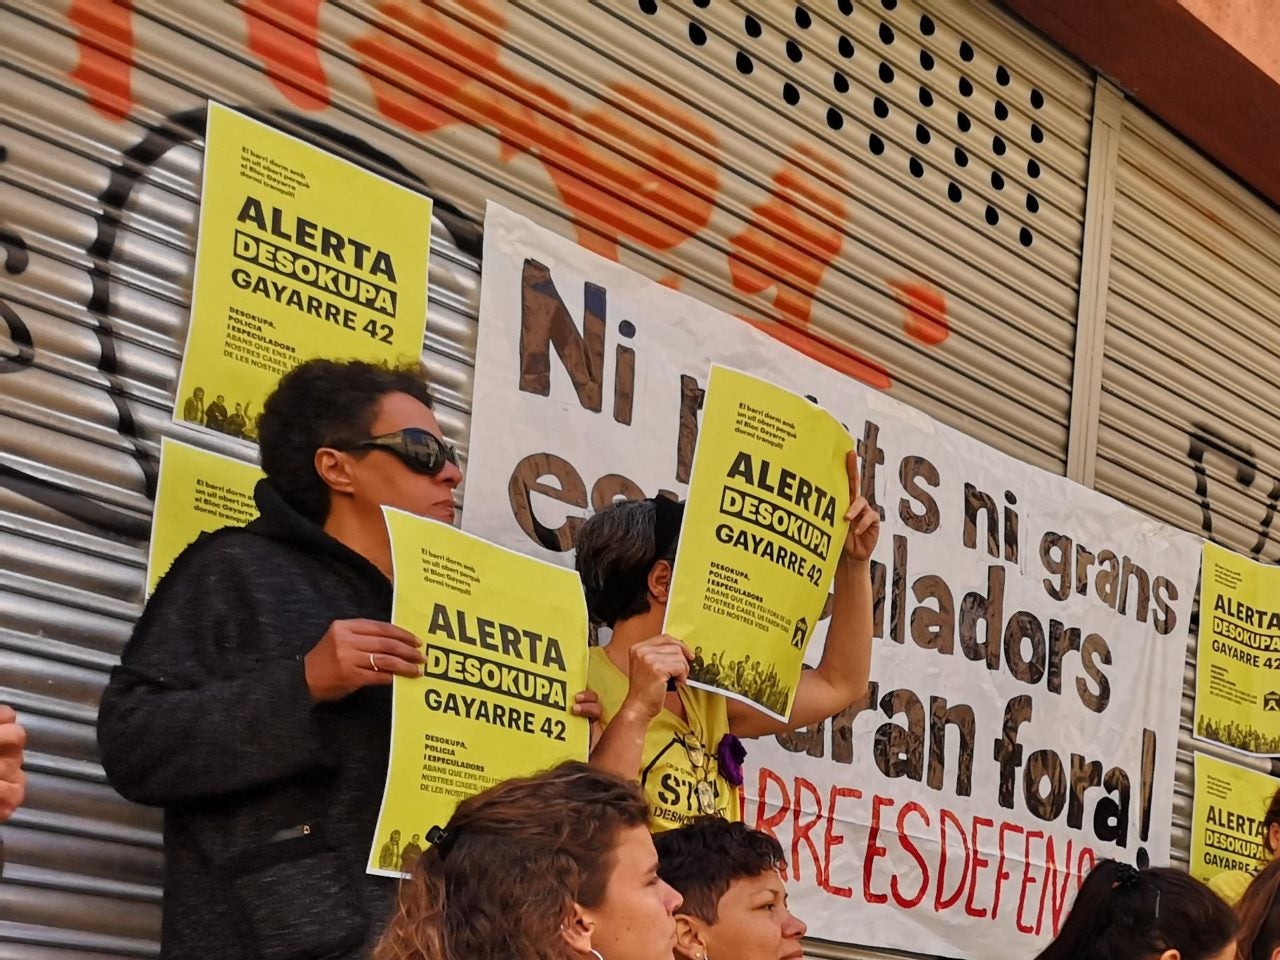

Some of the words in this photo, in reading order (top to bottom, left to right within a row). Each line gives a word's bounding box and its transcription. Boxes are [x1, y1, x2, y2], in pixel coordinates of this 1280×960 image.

[237, 196, 398, 284] ALERTA
[232, 268, 356, 331] GAYARRE
[362, 318, 394, 345] 42
[236, 236, 394, 316] DESOKUPA
[520, 258, 637, 427] Ni
[963, 482, 1018, 565] ni
[1039, 531, 1179, 635] grans
[727, 452, 836, 528] ALERTA
[721, 487, 829, 560] DESOKUPA
[716, 523, 806, 578] GAYARRE
[807, 562, 823, 588] 42
[428, 603, 566, 672] ALERTA
[1212, 639, 1260, 668] GAYARRE
[427, 648, 566, 708] DESOKUPA
[425, 688, 535, 734] GAYARRE
[540, 717, 566, 742] 42
[425, 734, 467, 749] DESOKUPA,
[425, 744, 455, 756] POLICIA
[428, 755, 484, 772] ESPECULADORS
[993, 695, 1157, 868] fora!
[1205, 830, 1264, 860] DESOKUPA
[1206, 806, 1266, 837] ALERTA
[1204, 852, 1250, 873] GAYARRE
